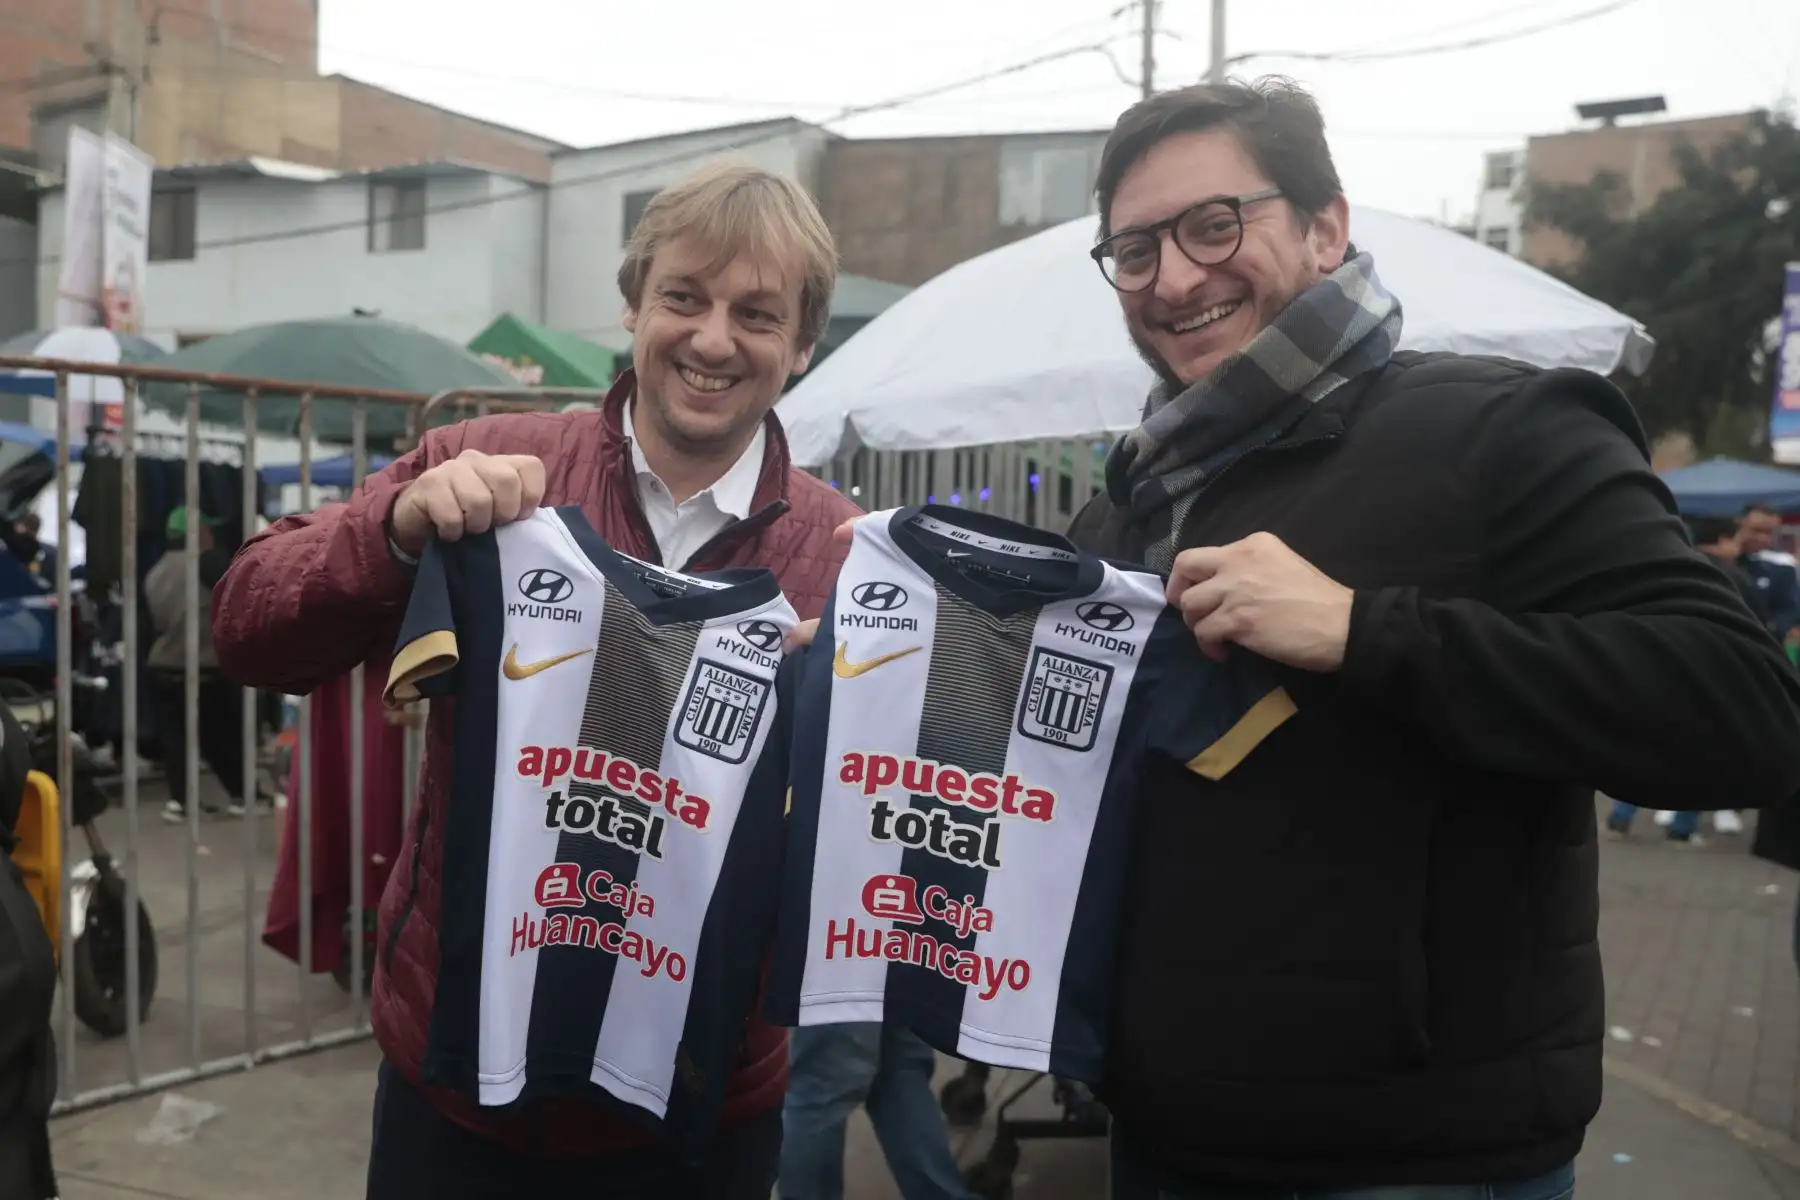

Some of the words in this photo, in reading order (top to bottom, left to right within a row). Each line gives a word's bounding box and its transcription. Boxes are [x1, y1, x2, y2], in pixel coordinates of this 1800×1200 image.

[950, 530, 971, 541] NIKE
[1000, 542, 1021, 553] NIKE
[507, 603, 582, 623] HYUNDAI
[840, 614, 918, 631] HYUNDAI
[716, 636, 781, 672] HYUNDA
[1054, 622, 1136, 657] HYUNDAI
[704, 667, 759, 696] ALIANZA
[1042, 656, 1100, 682] ALIANZA
[685, 685, 705, 721] CLUB
[1028, 676, 1044, 713] CLUB
[1083, 692, 1100, 728] LIMA
[737, 705, 757, 740] LIMA
[1042, 727, 1068, 742] 1901
[697, 737, 722, 753] 1901
[517, 745, 711, 829] apuesta
[839, 752, 1056, 822] apuesta
[545, 790, 666, 859] total
[870, 800, 1002, 868] total
[587, 870, 655, 918] Caja
[923, 885, 993, 937] Caja
[510, 911, 687, 982] Huancayo
[825, 917, 1031, 1001] Huancayo
